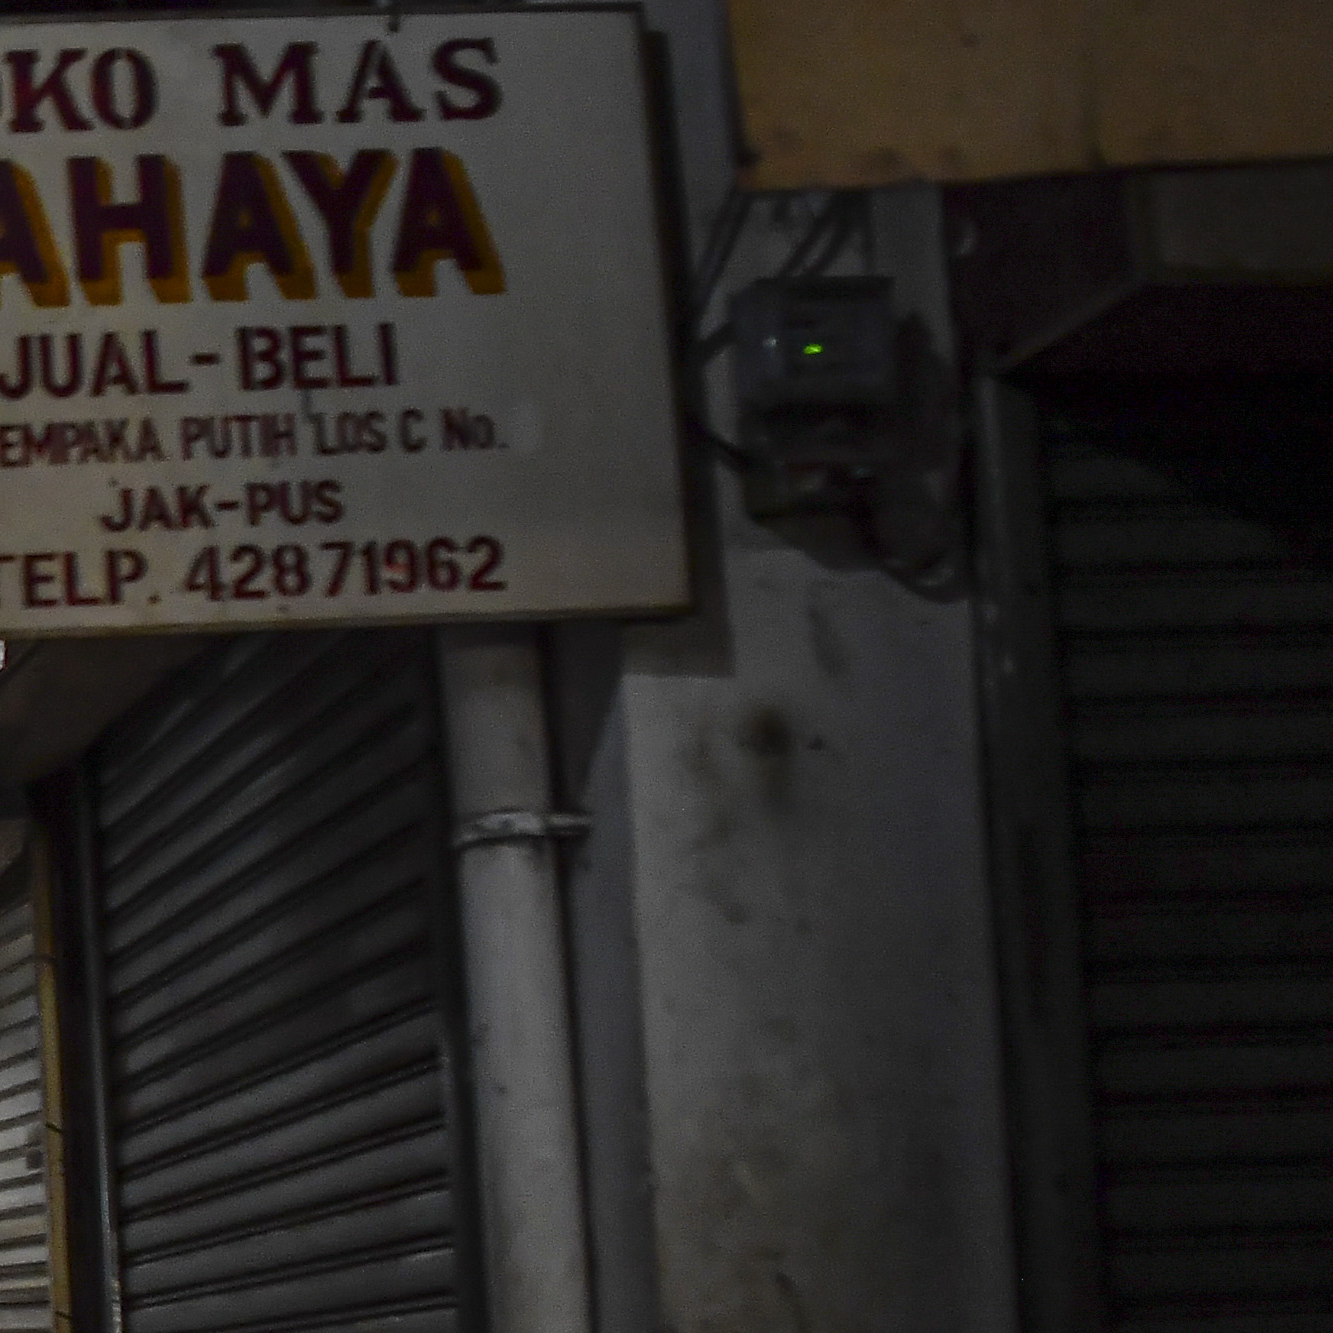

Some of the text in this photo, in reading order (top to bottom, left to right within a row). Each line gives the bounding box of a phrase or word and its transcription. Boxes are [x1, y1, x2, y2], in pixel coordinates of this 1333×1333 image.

[212, 36, 504, 129] MAS
[181, 412, 297, 461] PUTIH
[311, 409, 386, 456] LOS
[400, 408, 425, 454] C
[99, 479, 344, 532] JAK-PUS
[183, 535, 508, 602] 42871962
